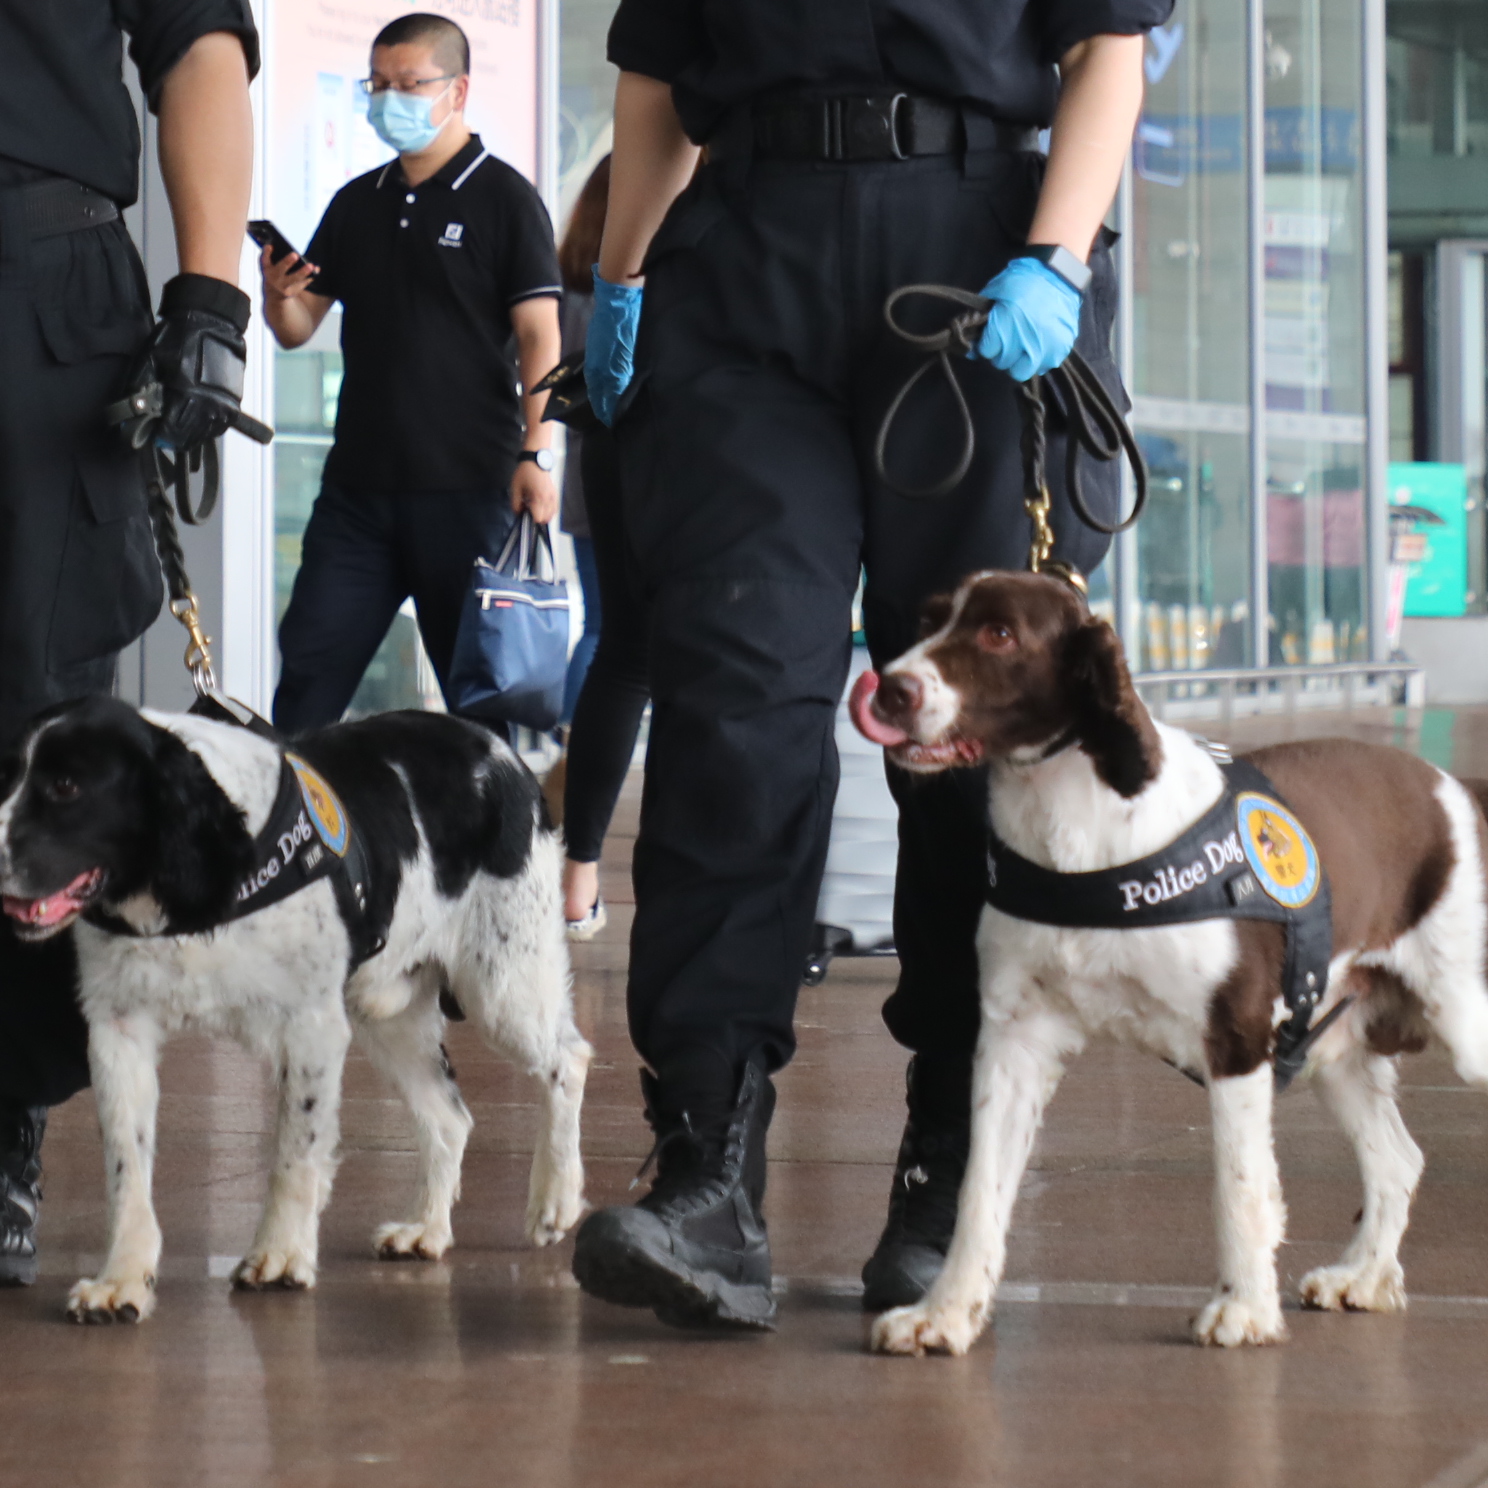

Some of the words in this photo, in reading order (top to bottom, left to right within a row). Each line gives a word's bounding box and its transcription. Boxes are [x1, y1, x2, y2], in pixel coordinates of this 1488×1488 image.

[277, 809, 313, 865] Dog
[1118, 860, 1208, 912] Police
[1202, 829, 1245, 876] Dog
